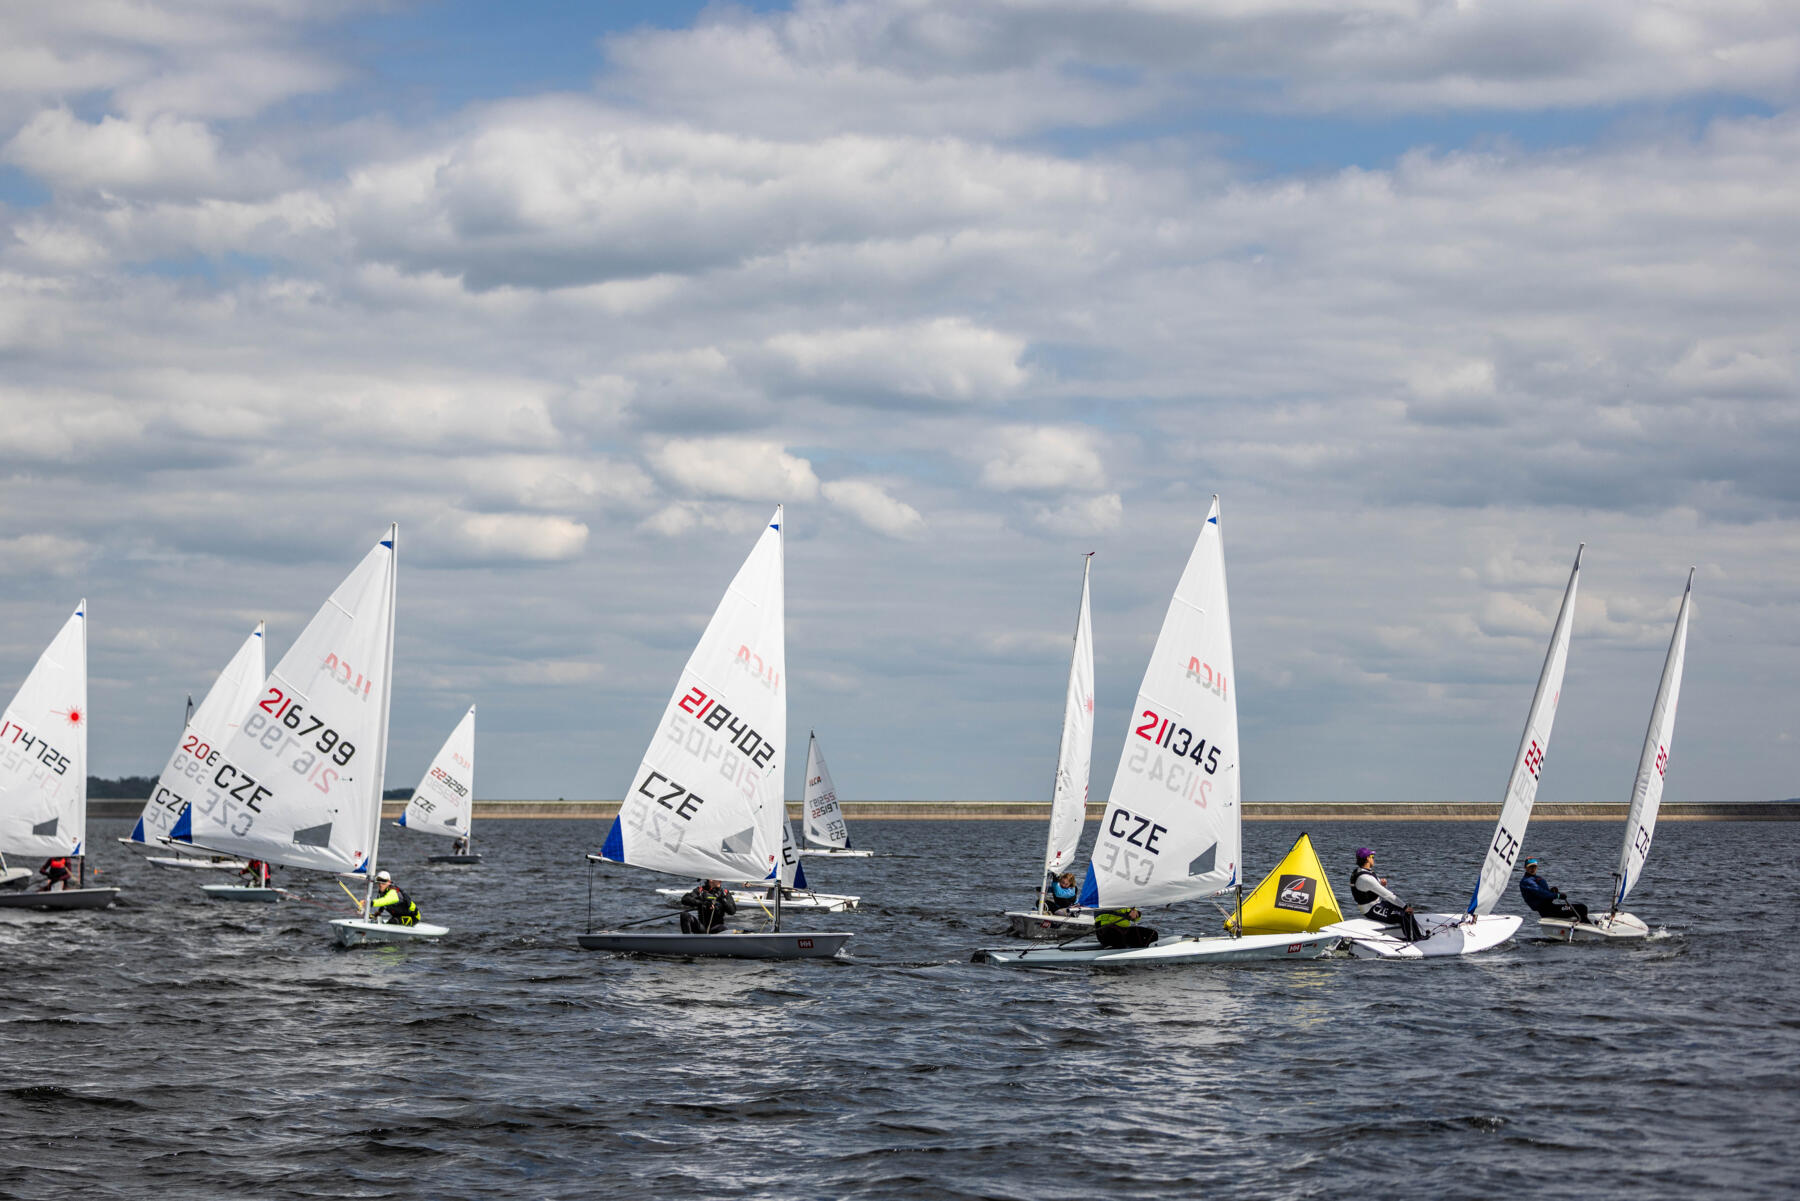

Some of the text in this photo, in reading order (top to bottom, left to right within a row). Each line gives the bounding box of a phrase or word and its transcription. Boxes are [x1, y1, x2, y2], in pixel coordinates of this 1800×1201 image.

[0, 721, 70, 776] 174725
[259, 687, 356, 766] 216799
[678, 686, 776, 769] 218402
[1135, 710, 1222, 776] 211345
[214, 764, 273, 814] CZE
[413, 795, 436, 814] CZE
[430, 767, 468, 797] 223290
[638, 771, 704, 821] CZE
[811, 801, 838, 819] 225197
[1109, 808, 1168, 855] CZE
[830, 829, 846, 841] CZE
[1493, 826, 1519, 866] CZE
